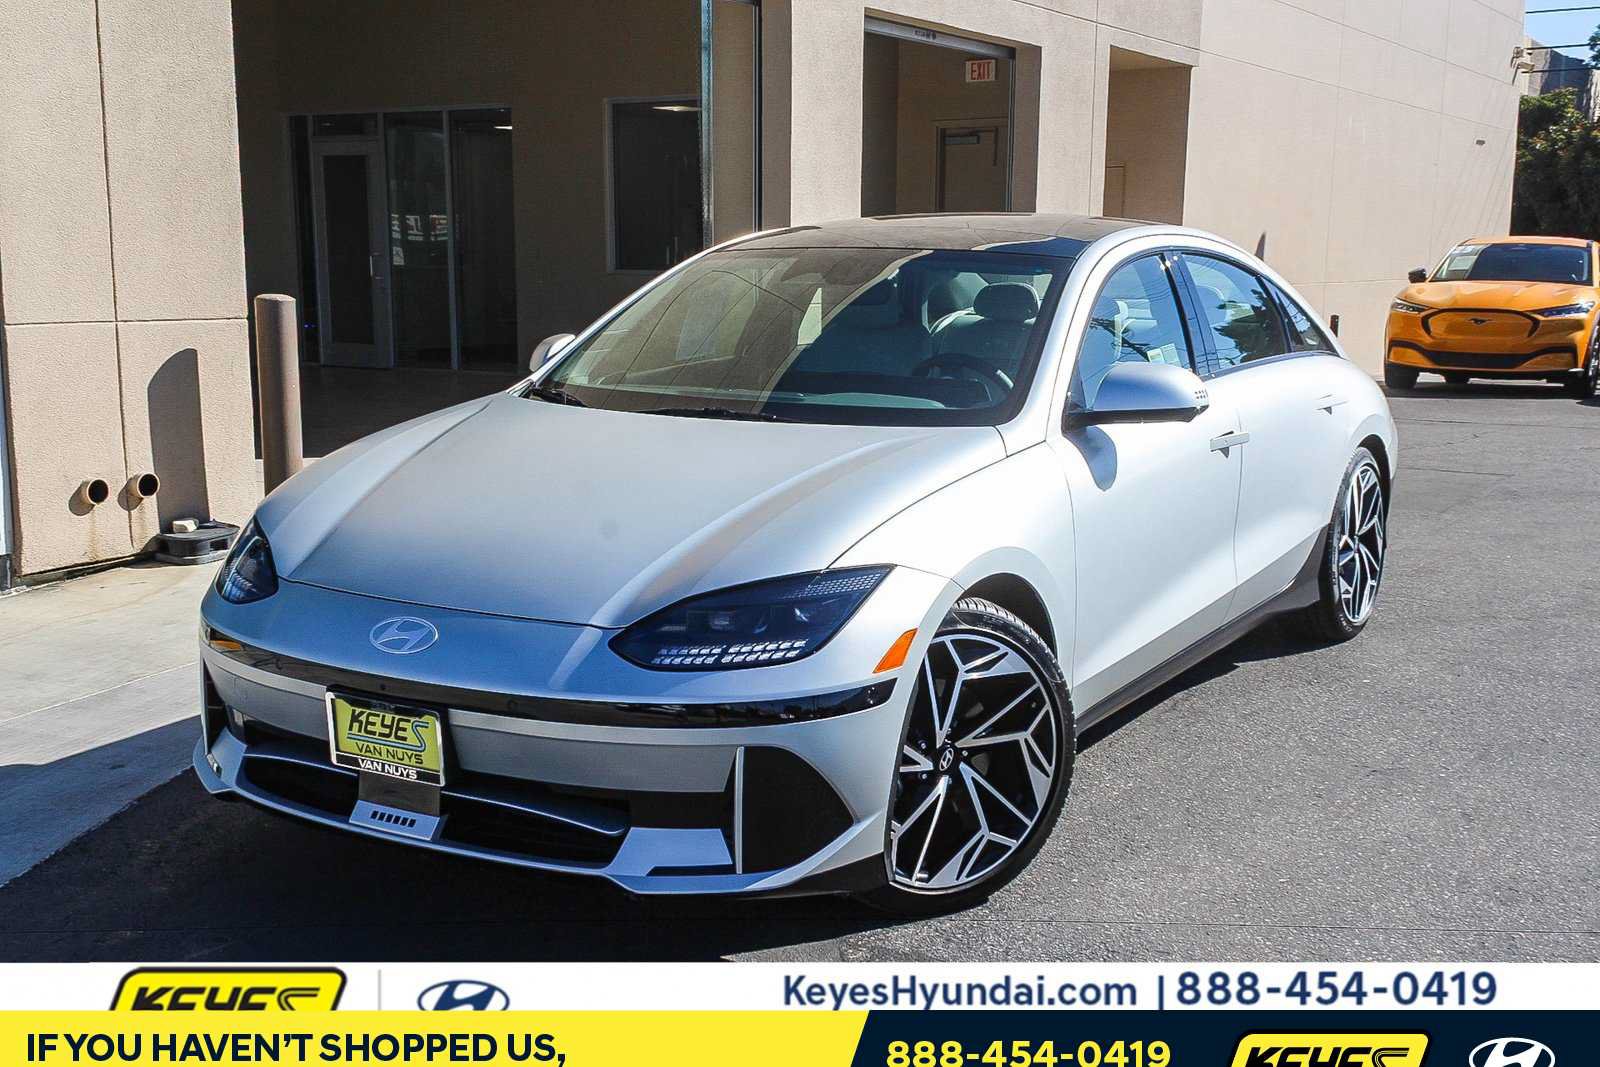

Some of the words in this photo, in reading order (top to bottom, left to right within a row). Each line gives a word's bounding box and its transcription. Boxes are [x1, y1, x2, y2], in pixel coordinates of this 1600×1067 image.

[970, 62, 992, 80] EXIT
[347, 708, 429, 752] KEYES
[356, 741, 383, 758] VAN
[386, 746, 424, 765] NUYS
[357, 758, 383, 771] VAN
[384, 763, 418, 780] NUYS
